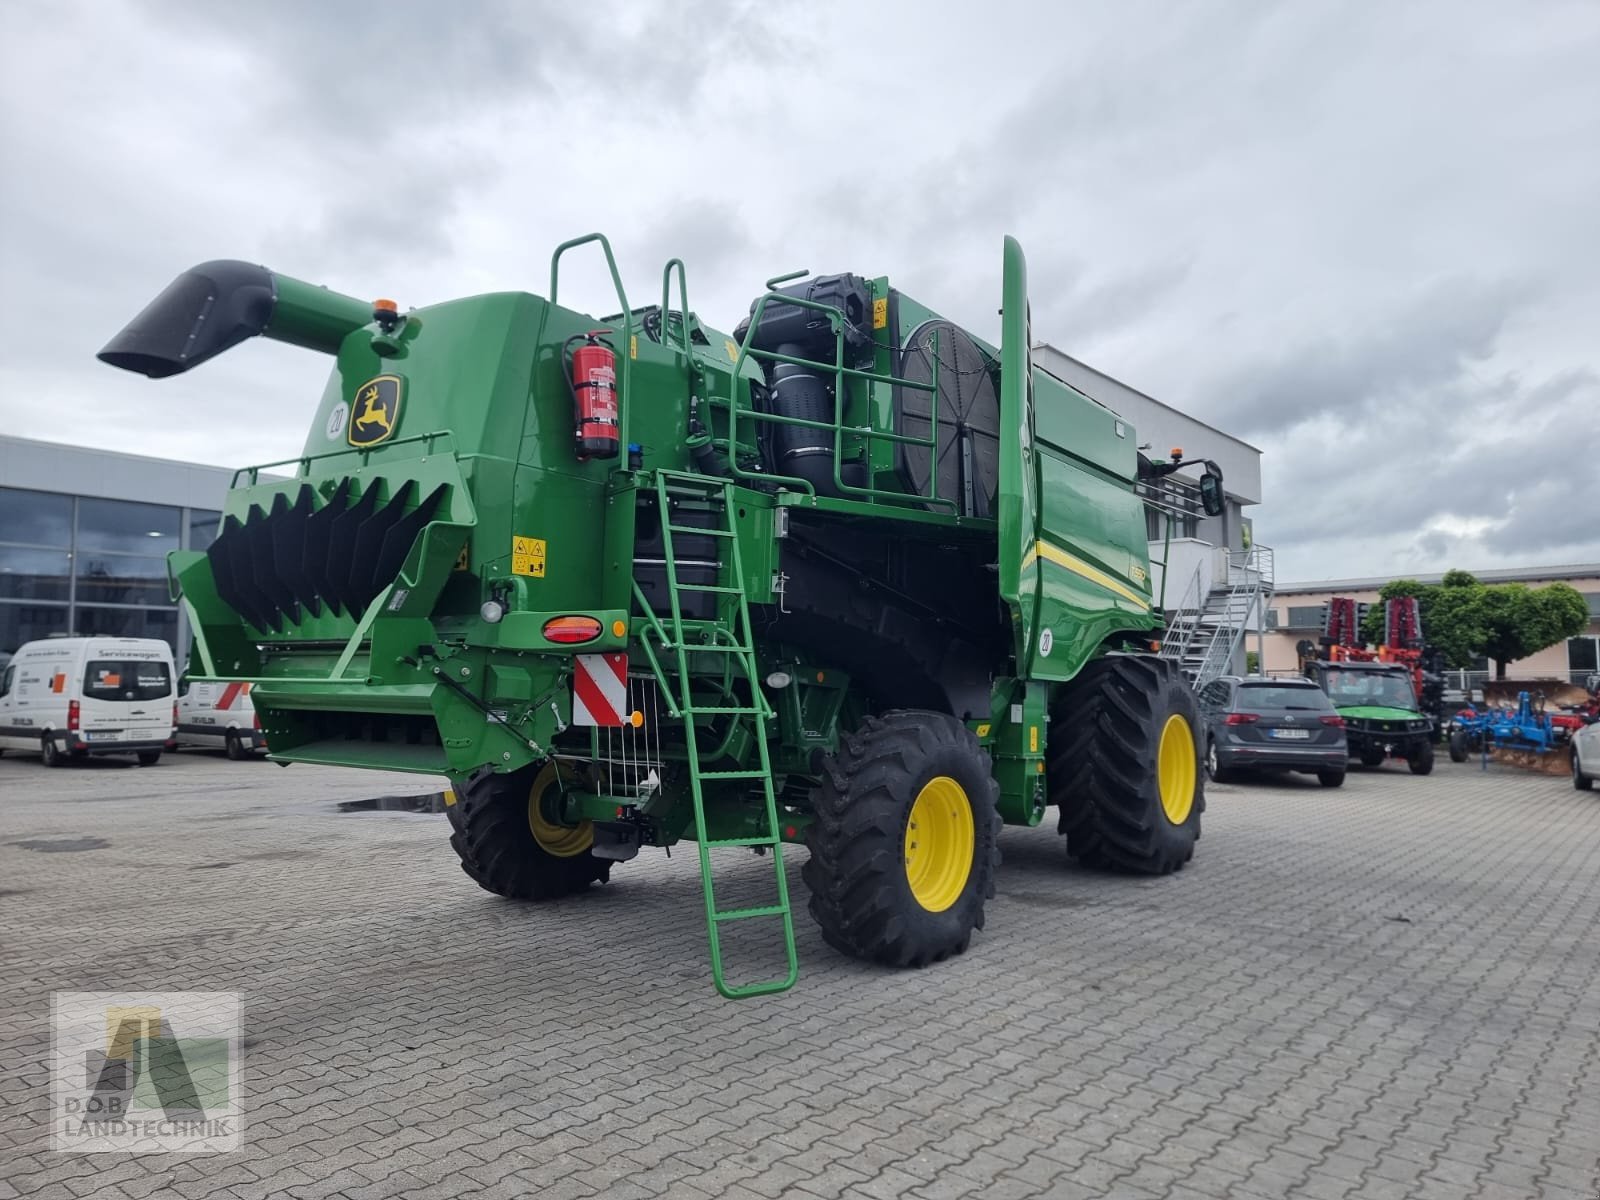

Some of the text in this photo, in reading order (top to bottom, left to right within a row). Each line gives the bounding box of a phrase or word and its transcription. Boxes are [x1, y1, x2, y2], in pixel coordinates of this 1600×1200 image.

[330, 408, 344, 433] 20
[1041, 633, 1051, 652] 20
[98, 649, 161, 660] Servicewagen
